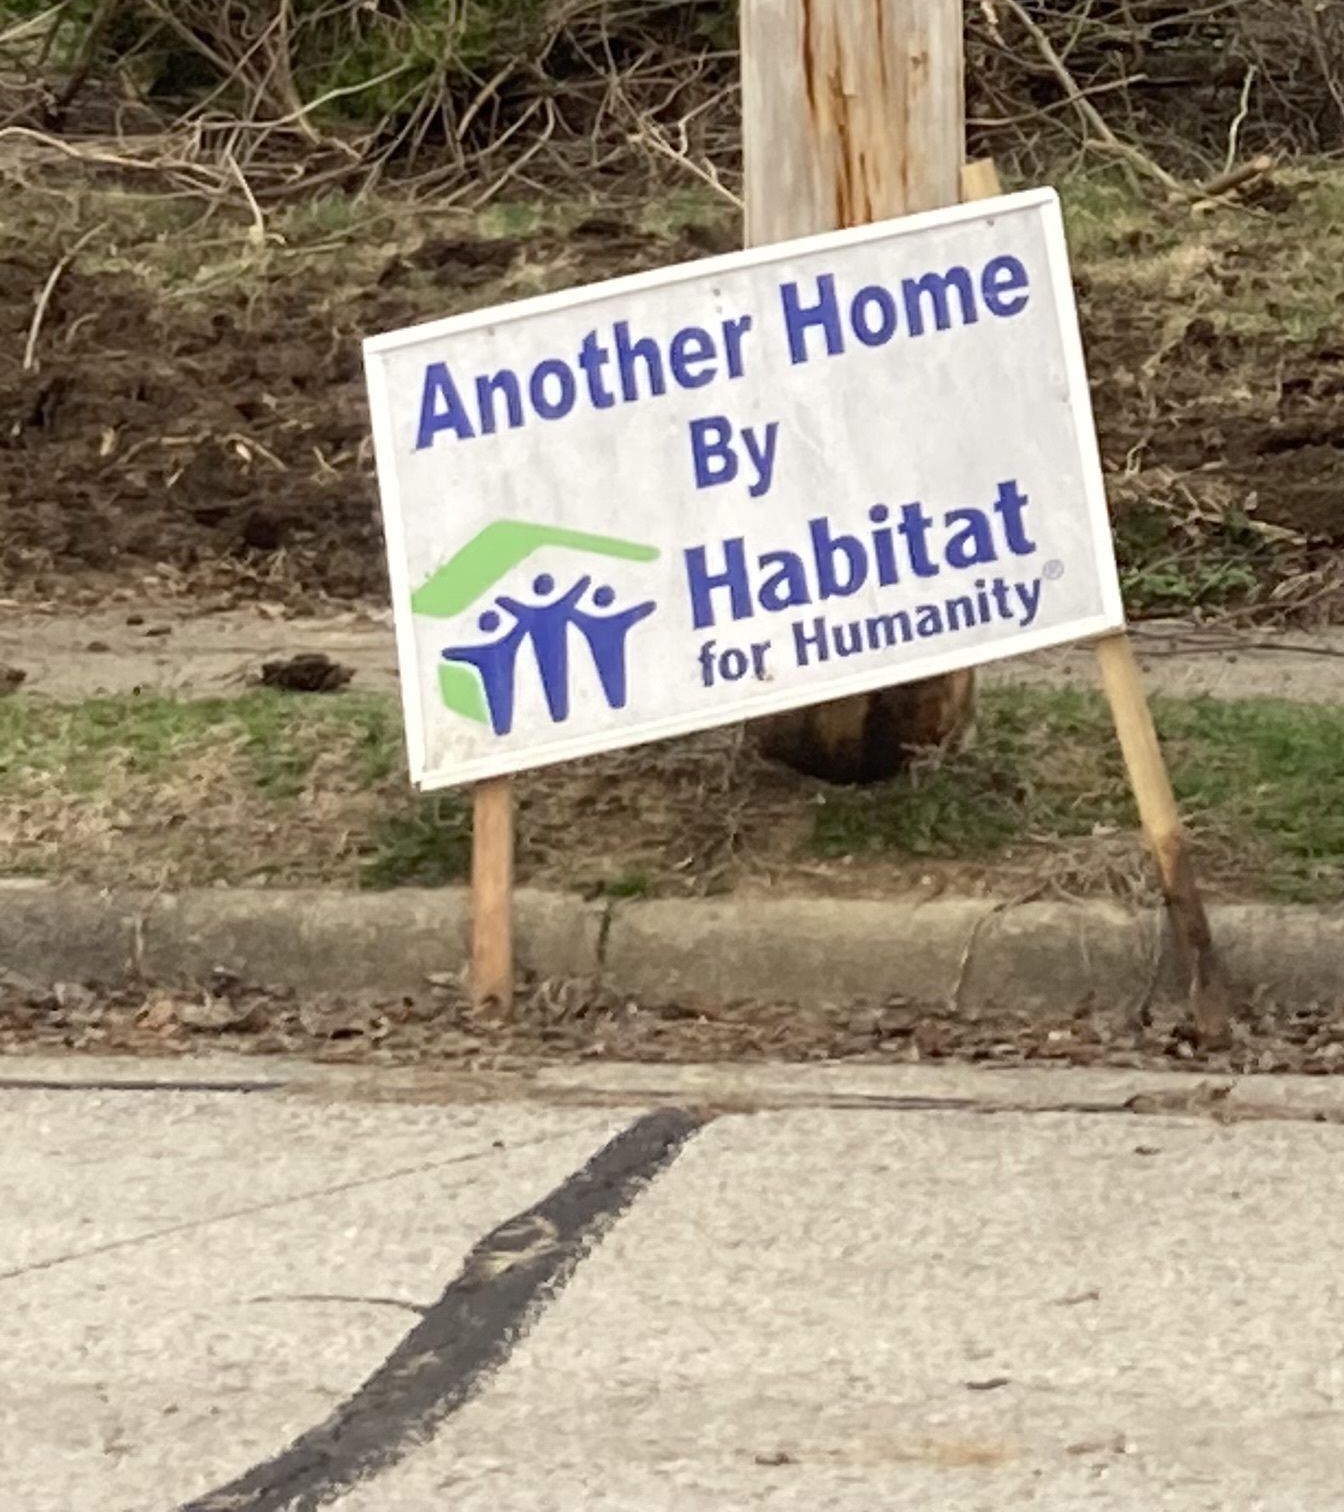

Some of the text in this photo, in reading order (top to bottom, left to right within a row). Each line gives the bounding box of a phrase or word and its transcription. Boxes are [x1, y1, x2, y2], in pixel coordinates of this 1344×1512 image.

[415, 254, 1030, 450] Another Home
[688, 414, 779, 498] By
[683, 479, 1037, 630] Habitat
[697, 575, 1044, 687] for Humanity
